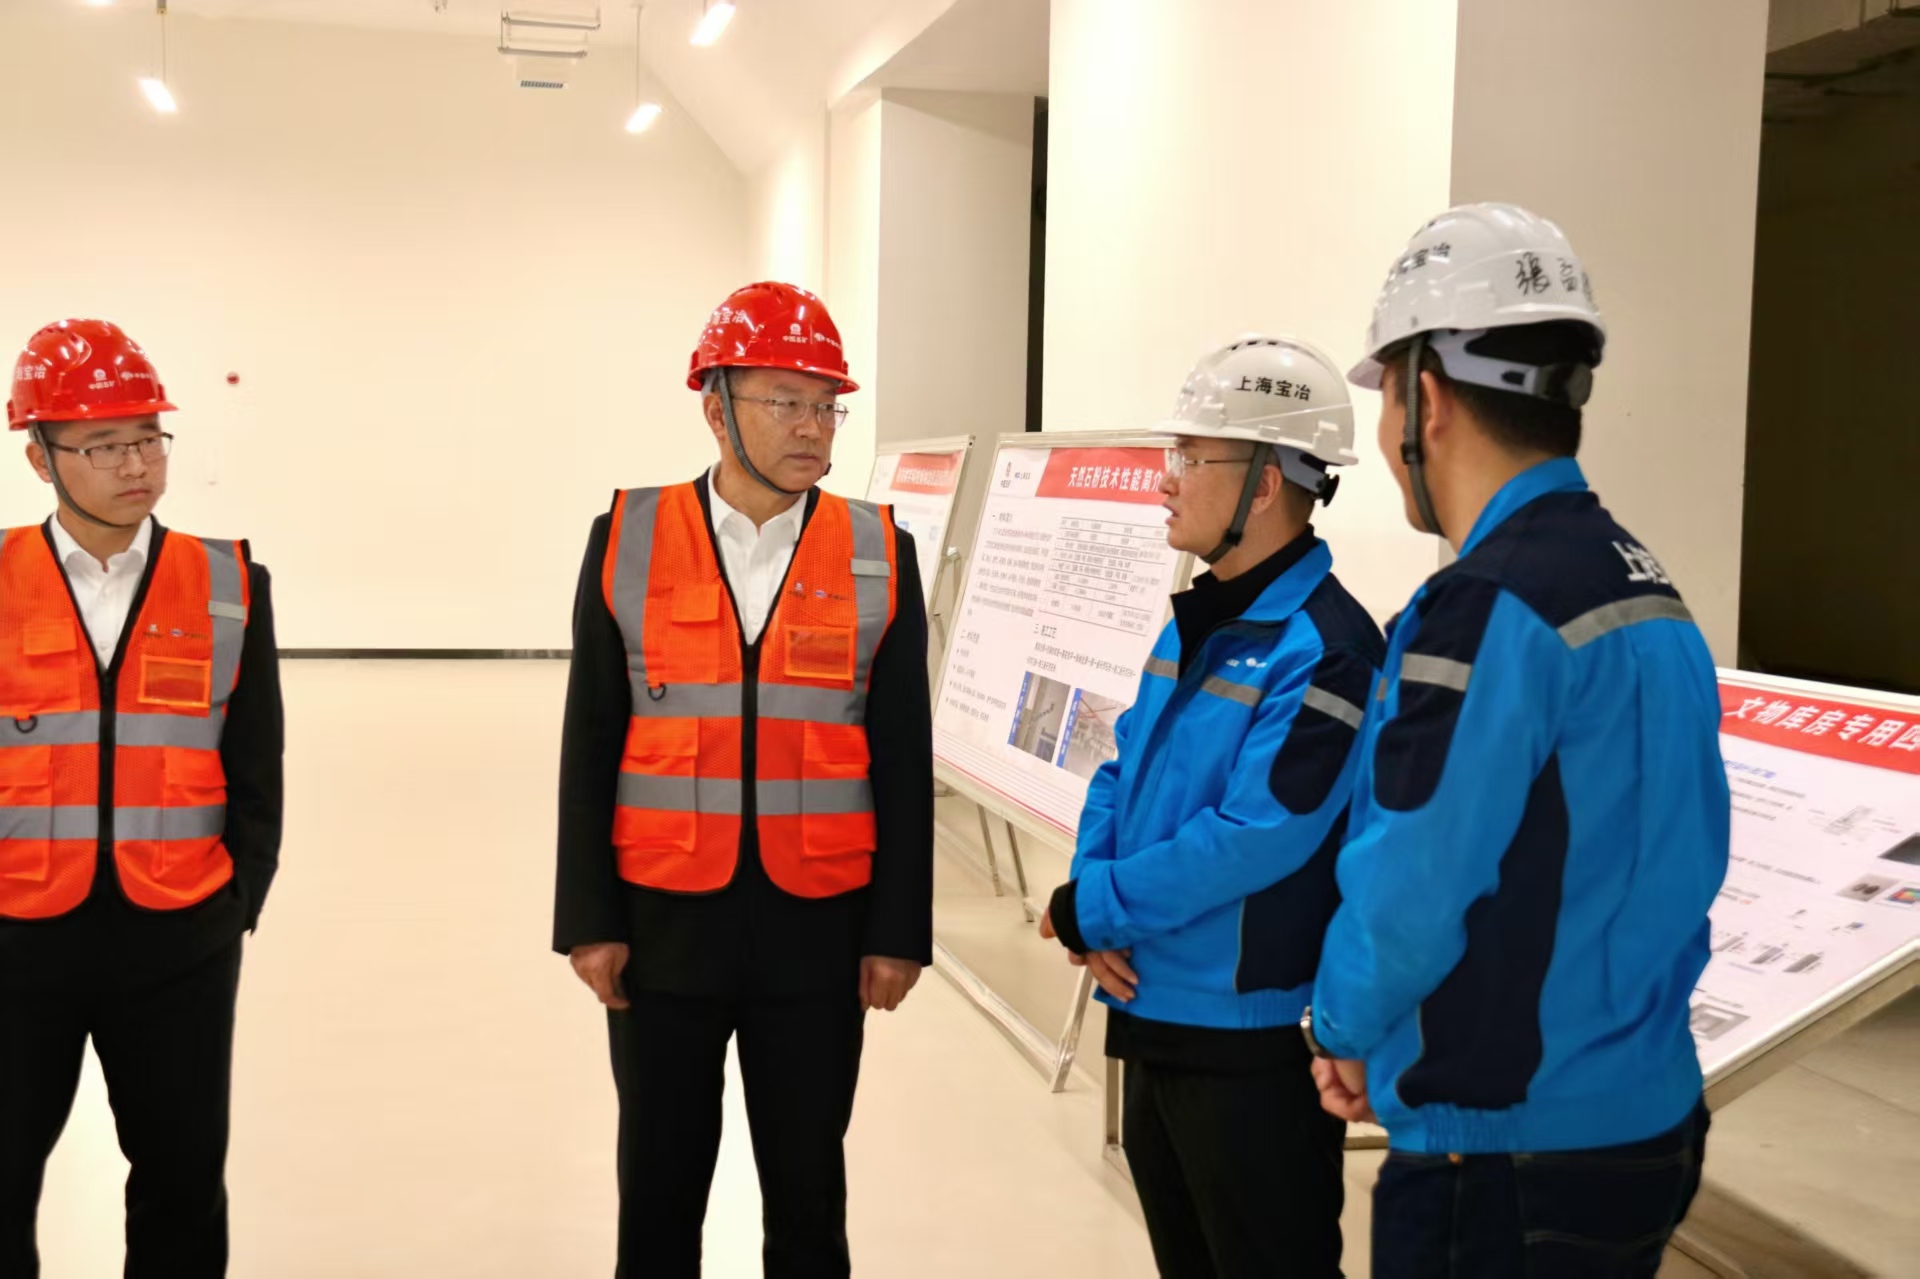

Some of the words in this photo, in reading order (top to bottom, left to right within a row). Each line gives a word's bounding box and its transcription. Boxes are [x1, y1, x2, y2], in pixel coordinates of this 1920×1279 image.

[1235, 375, 1312, 402] 上海宝冶
[1067, 465, 1164, 493] 天然石粉技术性能简介
